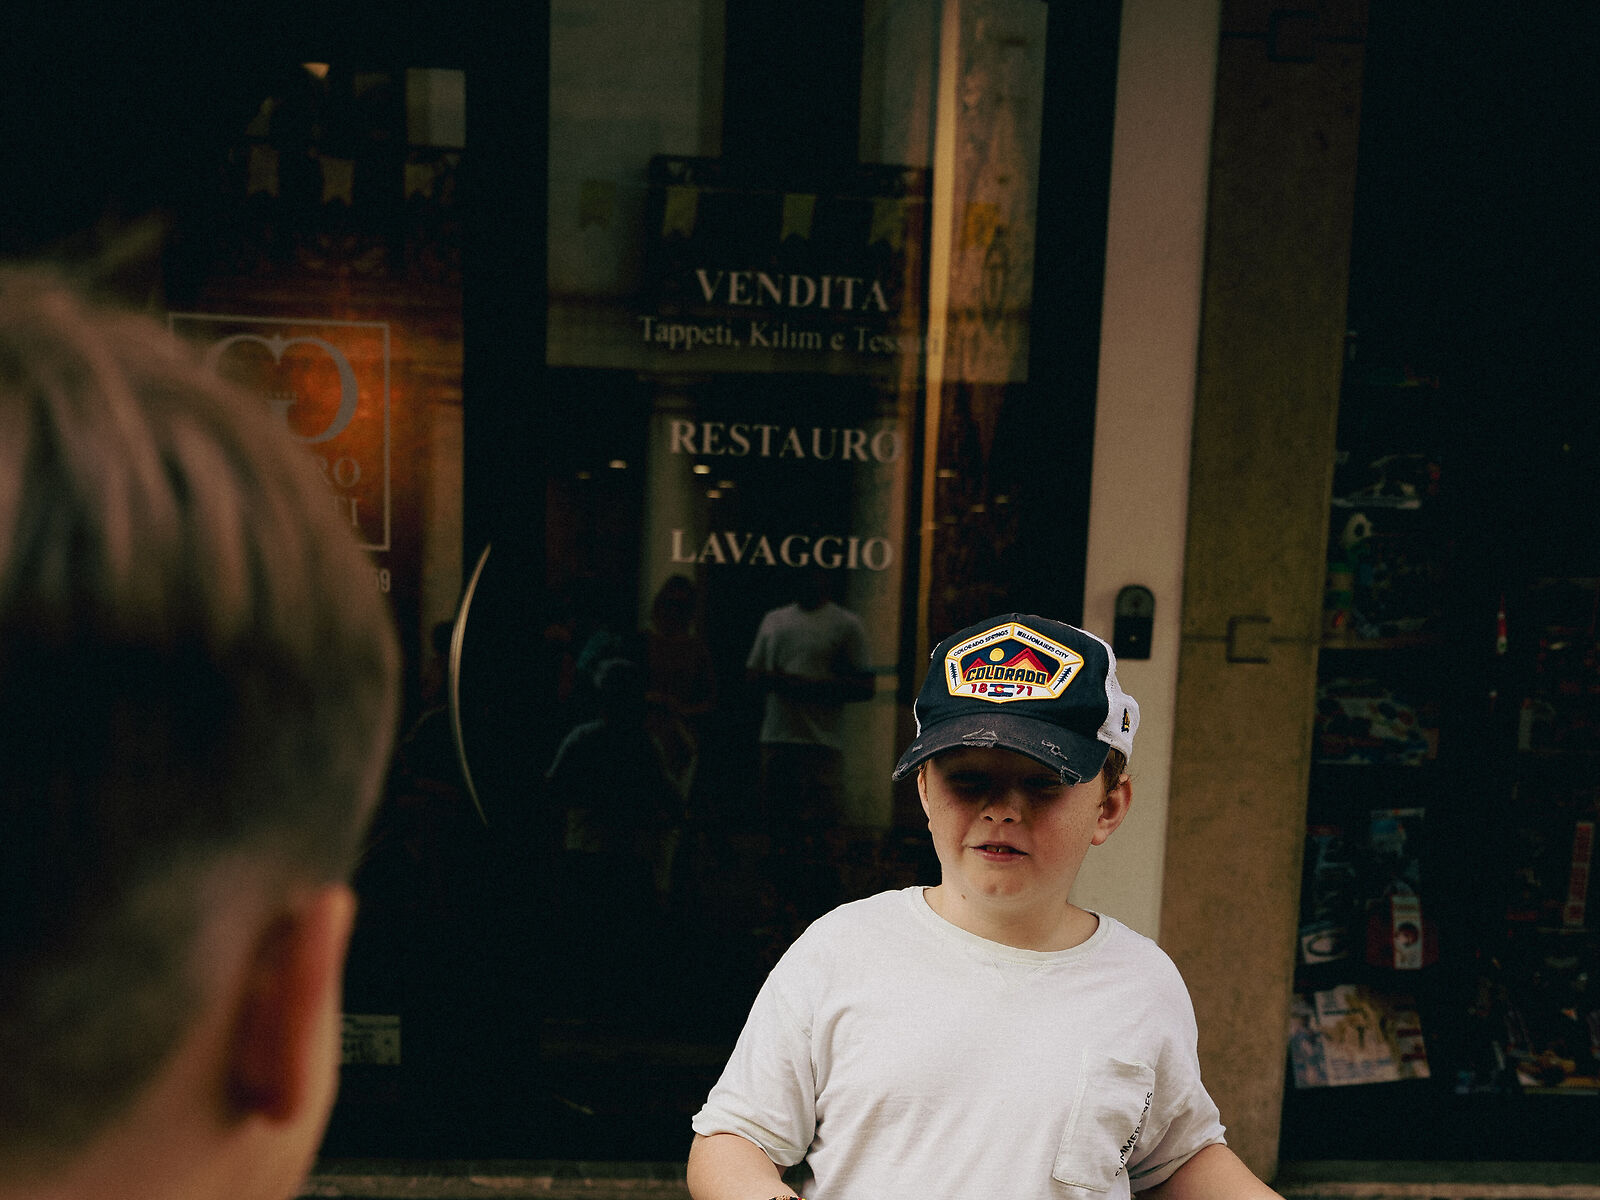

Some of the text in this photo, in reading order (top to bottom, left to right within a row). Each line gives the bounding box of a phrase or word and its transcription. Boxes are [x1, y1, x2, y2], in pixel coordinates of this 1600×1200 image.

[695, 268, 889, 312] VENDITA
[639, 316, 741, 350] Tappeti,
[749, 321, 823, 351] Kilim
[830, 333, 845, 352] e
[670, 419, 901, 463] RESTAURO
[670, 528, 896, 572] LAVAGGIO
[953, 630, 1009, 657] COLORADO SPRINGS
[1017, 630, 1069, 659] MILLIONAIRES CITY
[966, 665, 1048, 685] COLORADO
[971, 682, 988, 694] 18
[1016, 684, 1033, 697] 71
